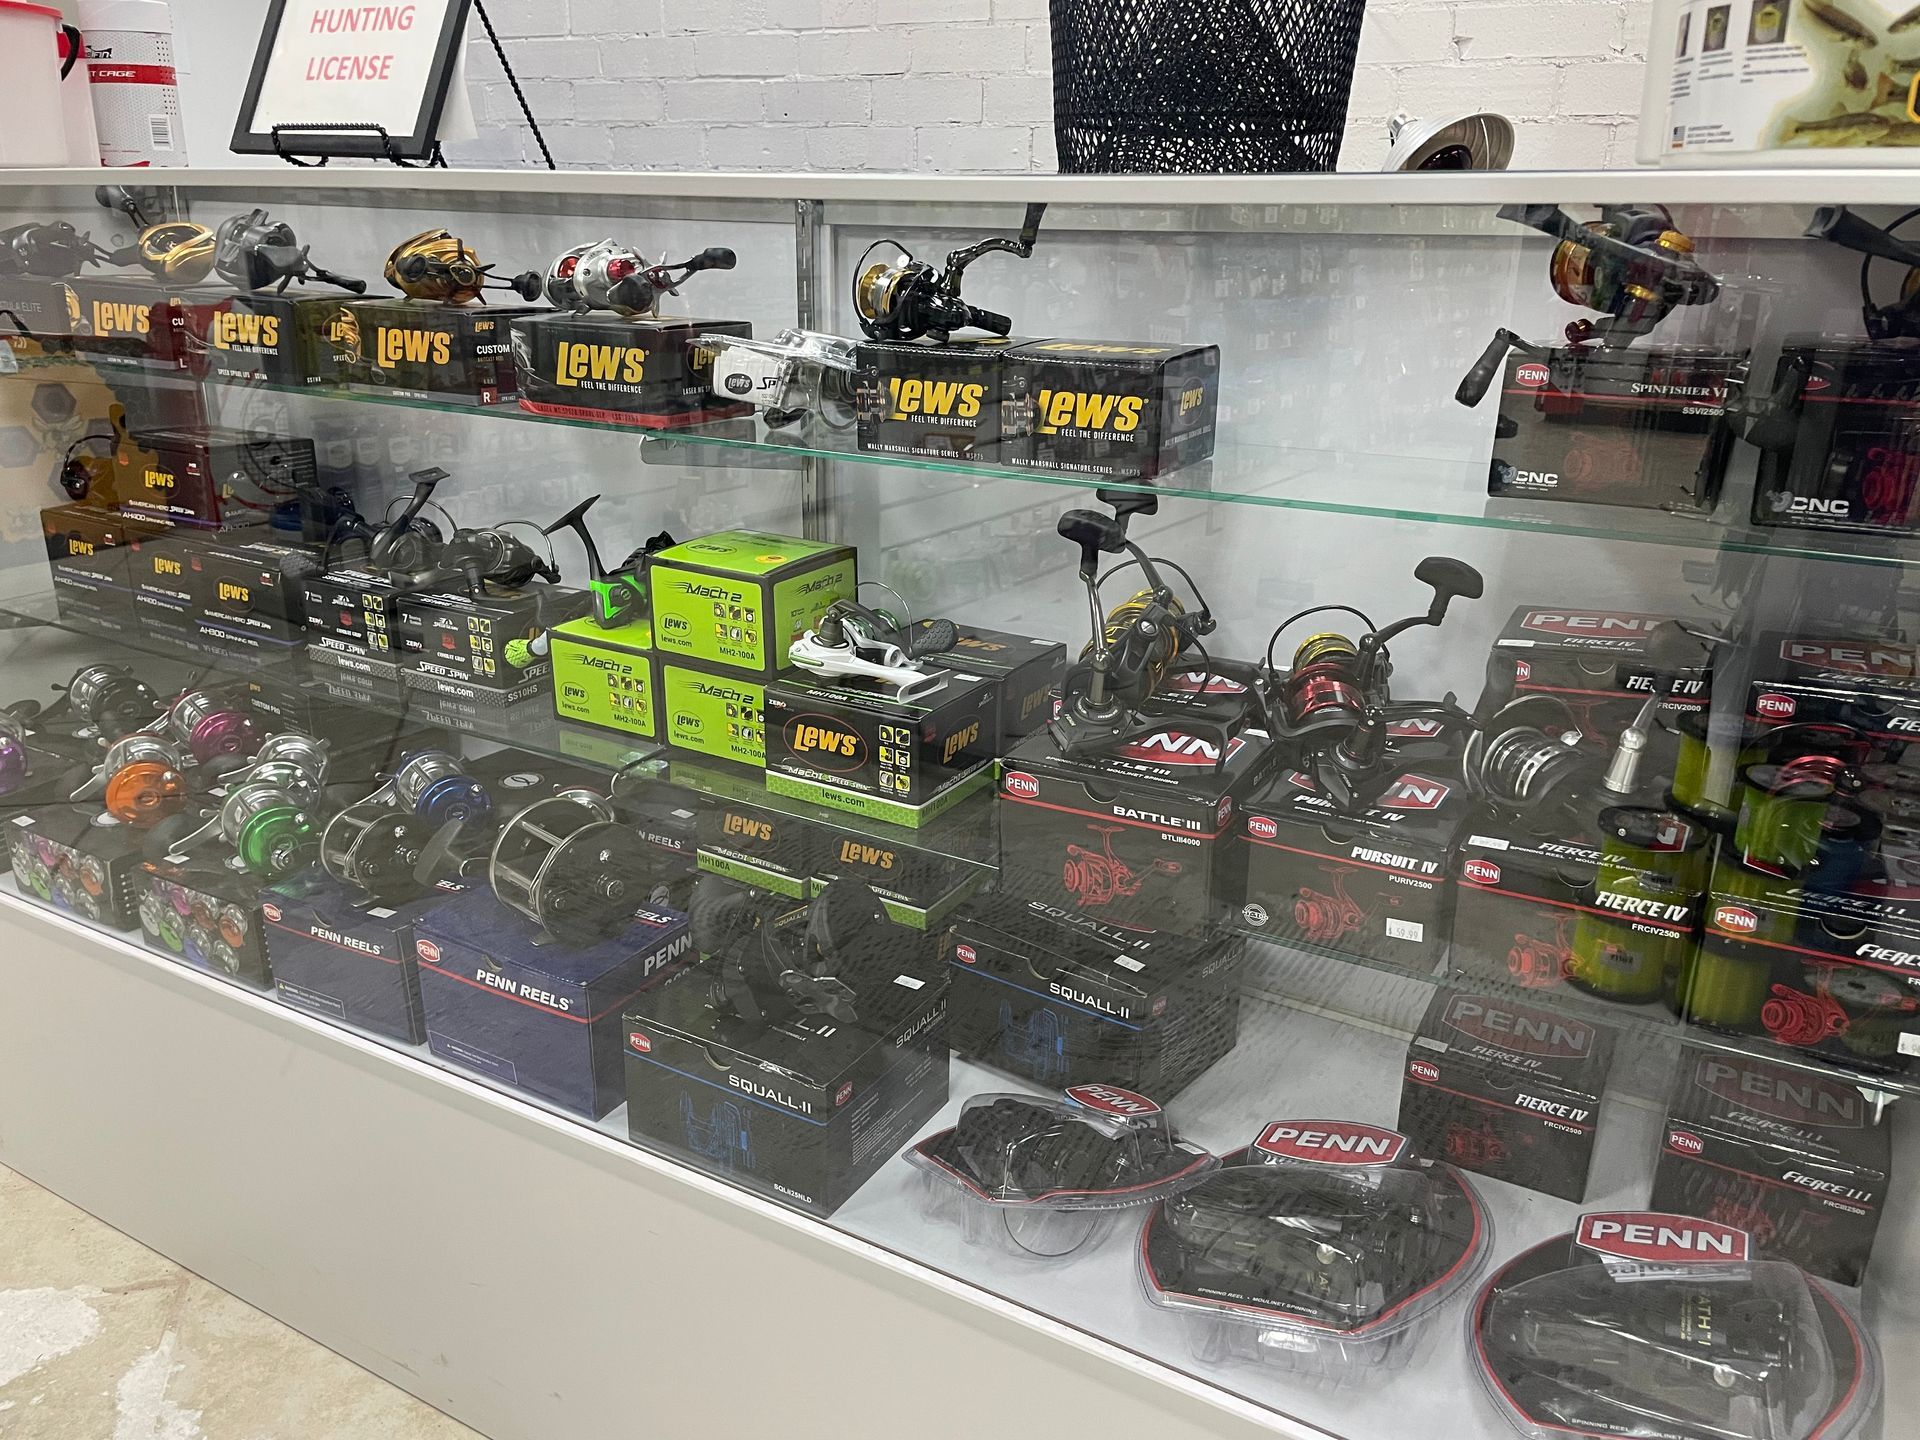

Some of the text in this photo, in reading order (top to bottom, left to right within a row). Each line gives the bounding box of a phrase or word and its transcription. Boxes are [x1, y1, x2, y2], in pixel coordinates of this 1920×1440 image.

[309, 5, 416, 33] HUNTING
[98, 70, 137, 78] CAGE
[305, 55, 394, 81] LICENSE
[213, 311, 278, 350] Lew's
[377, 327, 450, 369] Lew's
[476, 343, 510, 355] CUSTOM
[556, 341, 644, 387] Lew's
[1518, 369, 1548, 381] PENN
[581, 380, 642, 394] FEEL THE DIFFERENCE
[1713, 387, 1728, 398] VI
[483, 391, 491, 403] R
[886, 377, 983, 422] Lew's
[1033, 388, 1145, 435] Lew's
[911, 414, 977, 428] FEEL THE DIFFERENCE
[1060, 428, 1135, 443] FEEL THE DIFFERENCE
[867, 443, 960, 459] WALLY MARSHALL SIGNATURE SERIES
[1011, 457, 1113, 474] WALLY MARSHALL SIGNATURE SERIES
[1515, 471, 1559, 485] CNC
[1790, 497, 1849, 514] CNC
[685, 582, 742, 603] Mach 2
[319, 636, 367, 656] SPEED SPIN
[660, 634, 693, 648] lews.com
[1563, 637, 1637, 648] FIERCE IV
[719, 646, 756, 660] MH2-100A
[337, 655, 371, 672] lews.com
[416, 660, 470, 681] SPEED SPIN
[581, 654, 633, 674] Mach 2
[437, 680, 474, 698] lews.com
[507, 684, 538, 702] SS10HS
[698, 683, 755, 705] Mach 2
[1683, 680, 1704, 694] IV
[561, 701, 590, 715] lews.com
[1656, 702, 1702, 712] FRCIV2000
[1758, 699, 1794, 713] PENN
[613, 713, 647, 728] MH2-100A
[673, 730, 705, 745] lews.com
[793, 723, 857, 757] Lew's
[731, 744, 766, 759] MH2-100A
[1045, 755, 1180, 786] SPINNING MOULINET SPINNING
[1007, 777, 1038, 793] PENN
[821, 788, 865, 808] lews.com
[1113, 805, 1201, 831] BATTLE III
[1217, 805, 1232, 820] PENN
[1249, 821, 1276, 834] PENN
[648, 833, 681, 849] REELS
[1161, 833, 1201, 847] BTLIII4000
[839, 840, 895, 870] Lew's
[1351, 846, 1439, 874] PURSUIT IV
[1510, 845, 1544, 856] SPINNING
[1575, 857, 1614, 869] MOULINET
[1537, 842, 1627, 863] FIERCE IV
[698, 855, 731, 872] MH100A
[1466, 864, 1499, 880] PENN
[1388, 874, 1433, 890] PURIV2500
[263, 906, 281, 920] PENN
[1594, 890, 1688, 922] FIERCE IV
[1841, 905, 1885, 918] MOULINET
[1028, 901, 1127, 943] SQUALL
[1133, 940, 1151, 950] II
[1717, 911, 1755, 929] PENN
[1396, 926, 1419, 940] 59.99
[1631, 923, 1680, 939] FRCIV2500
[310, 925, 381, 955] PENN REELS
[417, 943, 440, 959] PENN
[643, 931, 692, 977] PENN
[958, 947, 976, 960] PENN
[475, 968, 570, 1011] PENN REELS
[1049, 982, 1130, 1019] SQUALL II
[896, 999, 947, 1049] SQUALL II
[1452, 1000, 1586, 1050] PENN
[630, 1034, 650, 1049] PENN
[1472, 1045, 1542, 1068] FIERCE IV
[1411, 1063, 1438, 1078] PENN
[728, 1074, 812, 1115] SQUALL II
[836, 1083, 852, 1104] PENN
[1074, 1085, 1148, 1113] PENN
[1705, 1061, 1854, 1120] PENN
[1514, 1093, 1589, 1122] FIERCE IV
[1543, 1120, 1582, 1135] FRCIV2500
[1726, 1111, 1792, 1131] FIERCE
[1267, 1126, 1392, 1155] PENN
[1671, 1134, 1702, 1150] PENN
[1782, 1170, 1872, 1202] FIERCE III
[1590, 1220, 1733, 1254] PENN
[1197, 1287, 1318, 1315] SPINNING REEL MOULINET SPINNING
[1571, 1418, 1629, 1432] SPINNING REEL
